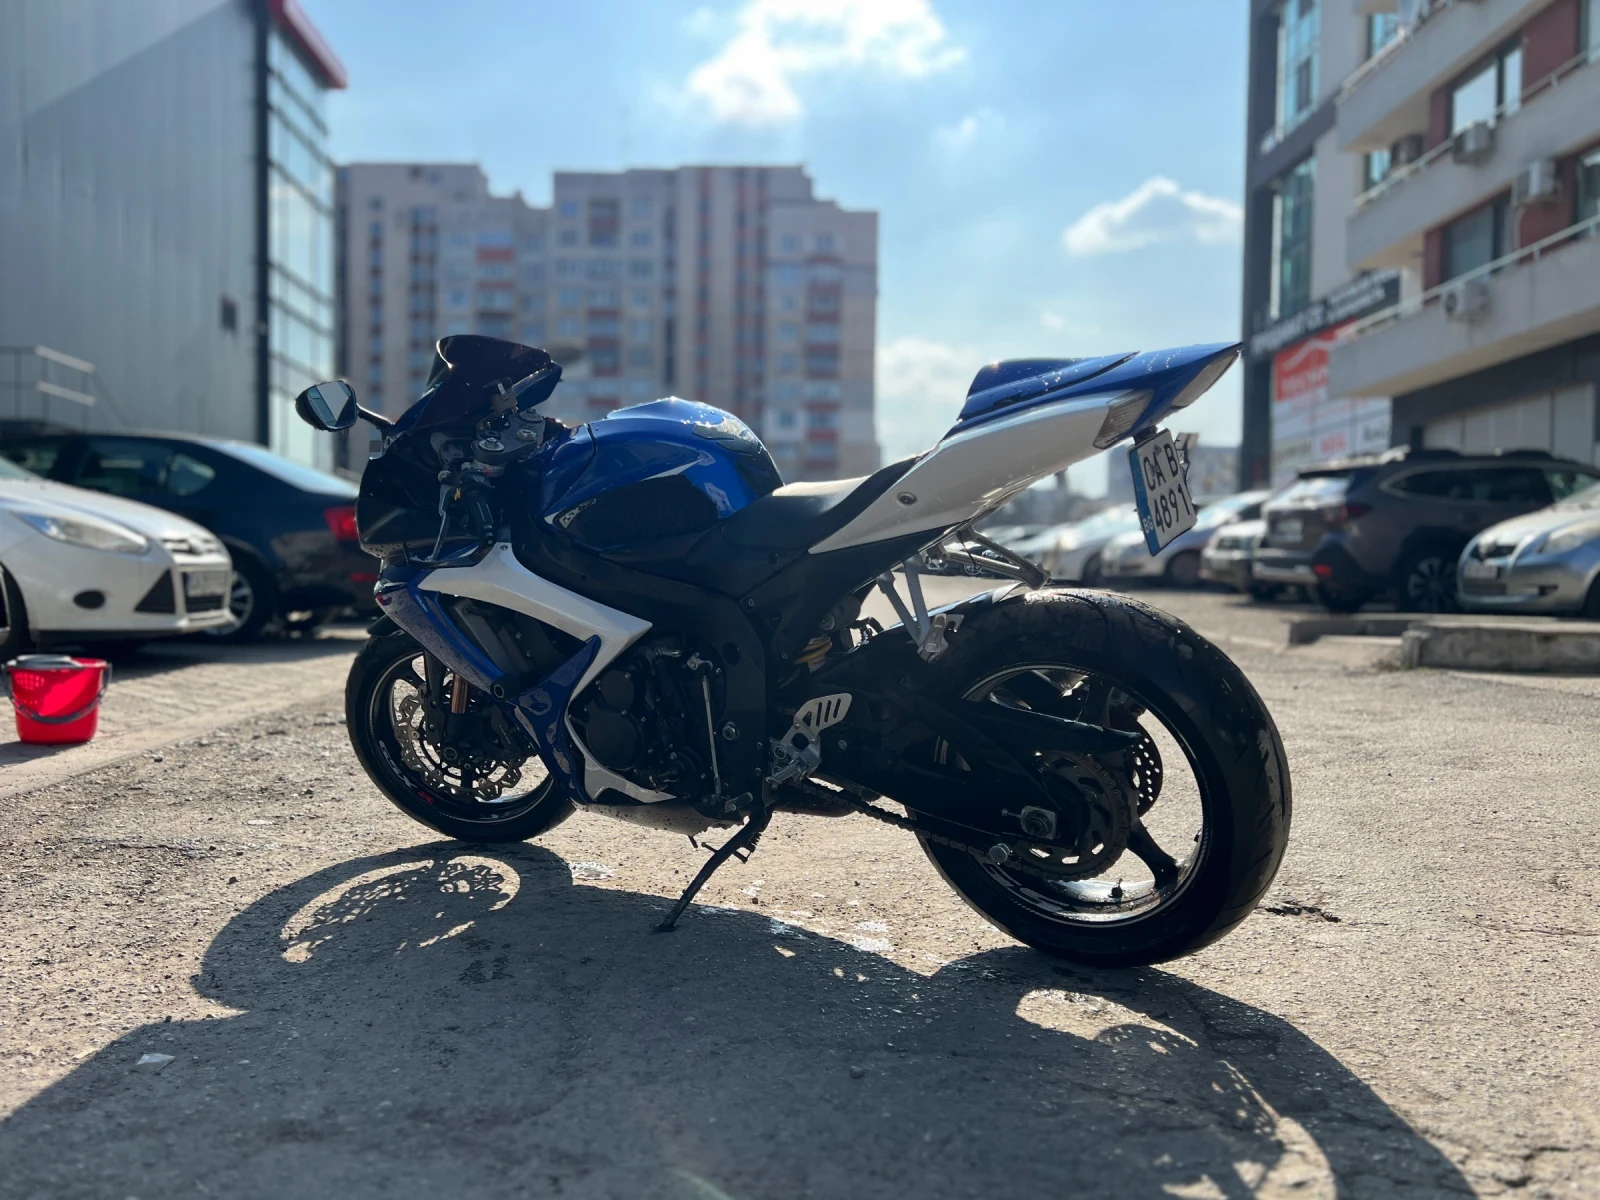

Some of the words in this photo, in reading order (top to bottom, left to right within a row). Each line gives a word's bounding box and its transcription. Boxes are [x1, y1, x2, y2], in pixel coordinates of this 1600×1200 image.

[1143, 450, 1166, 491] CA
[1163, 444, 1178, 477] B
[1143, 517, 1154, 534] BG
[1154, 483, 1190, 533] 4891
